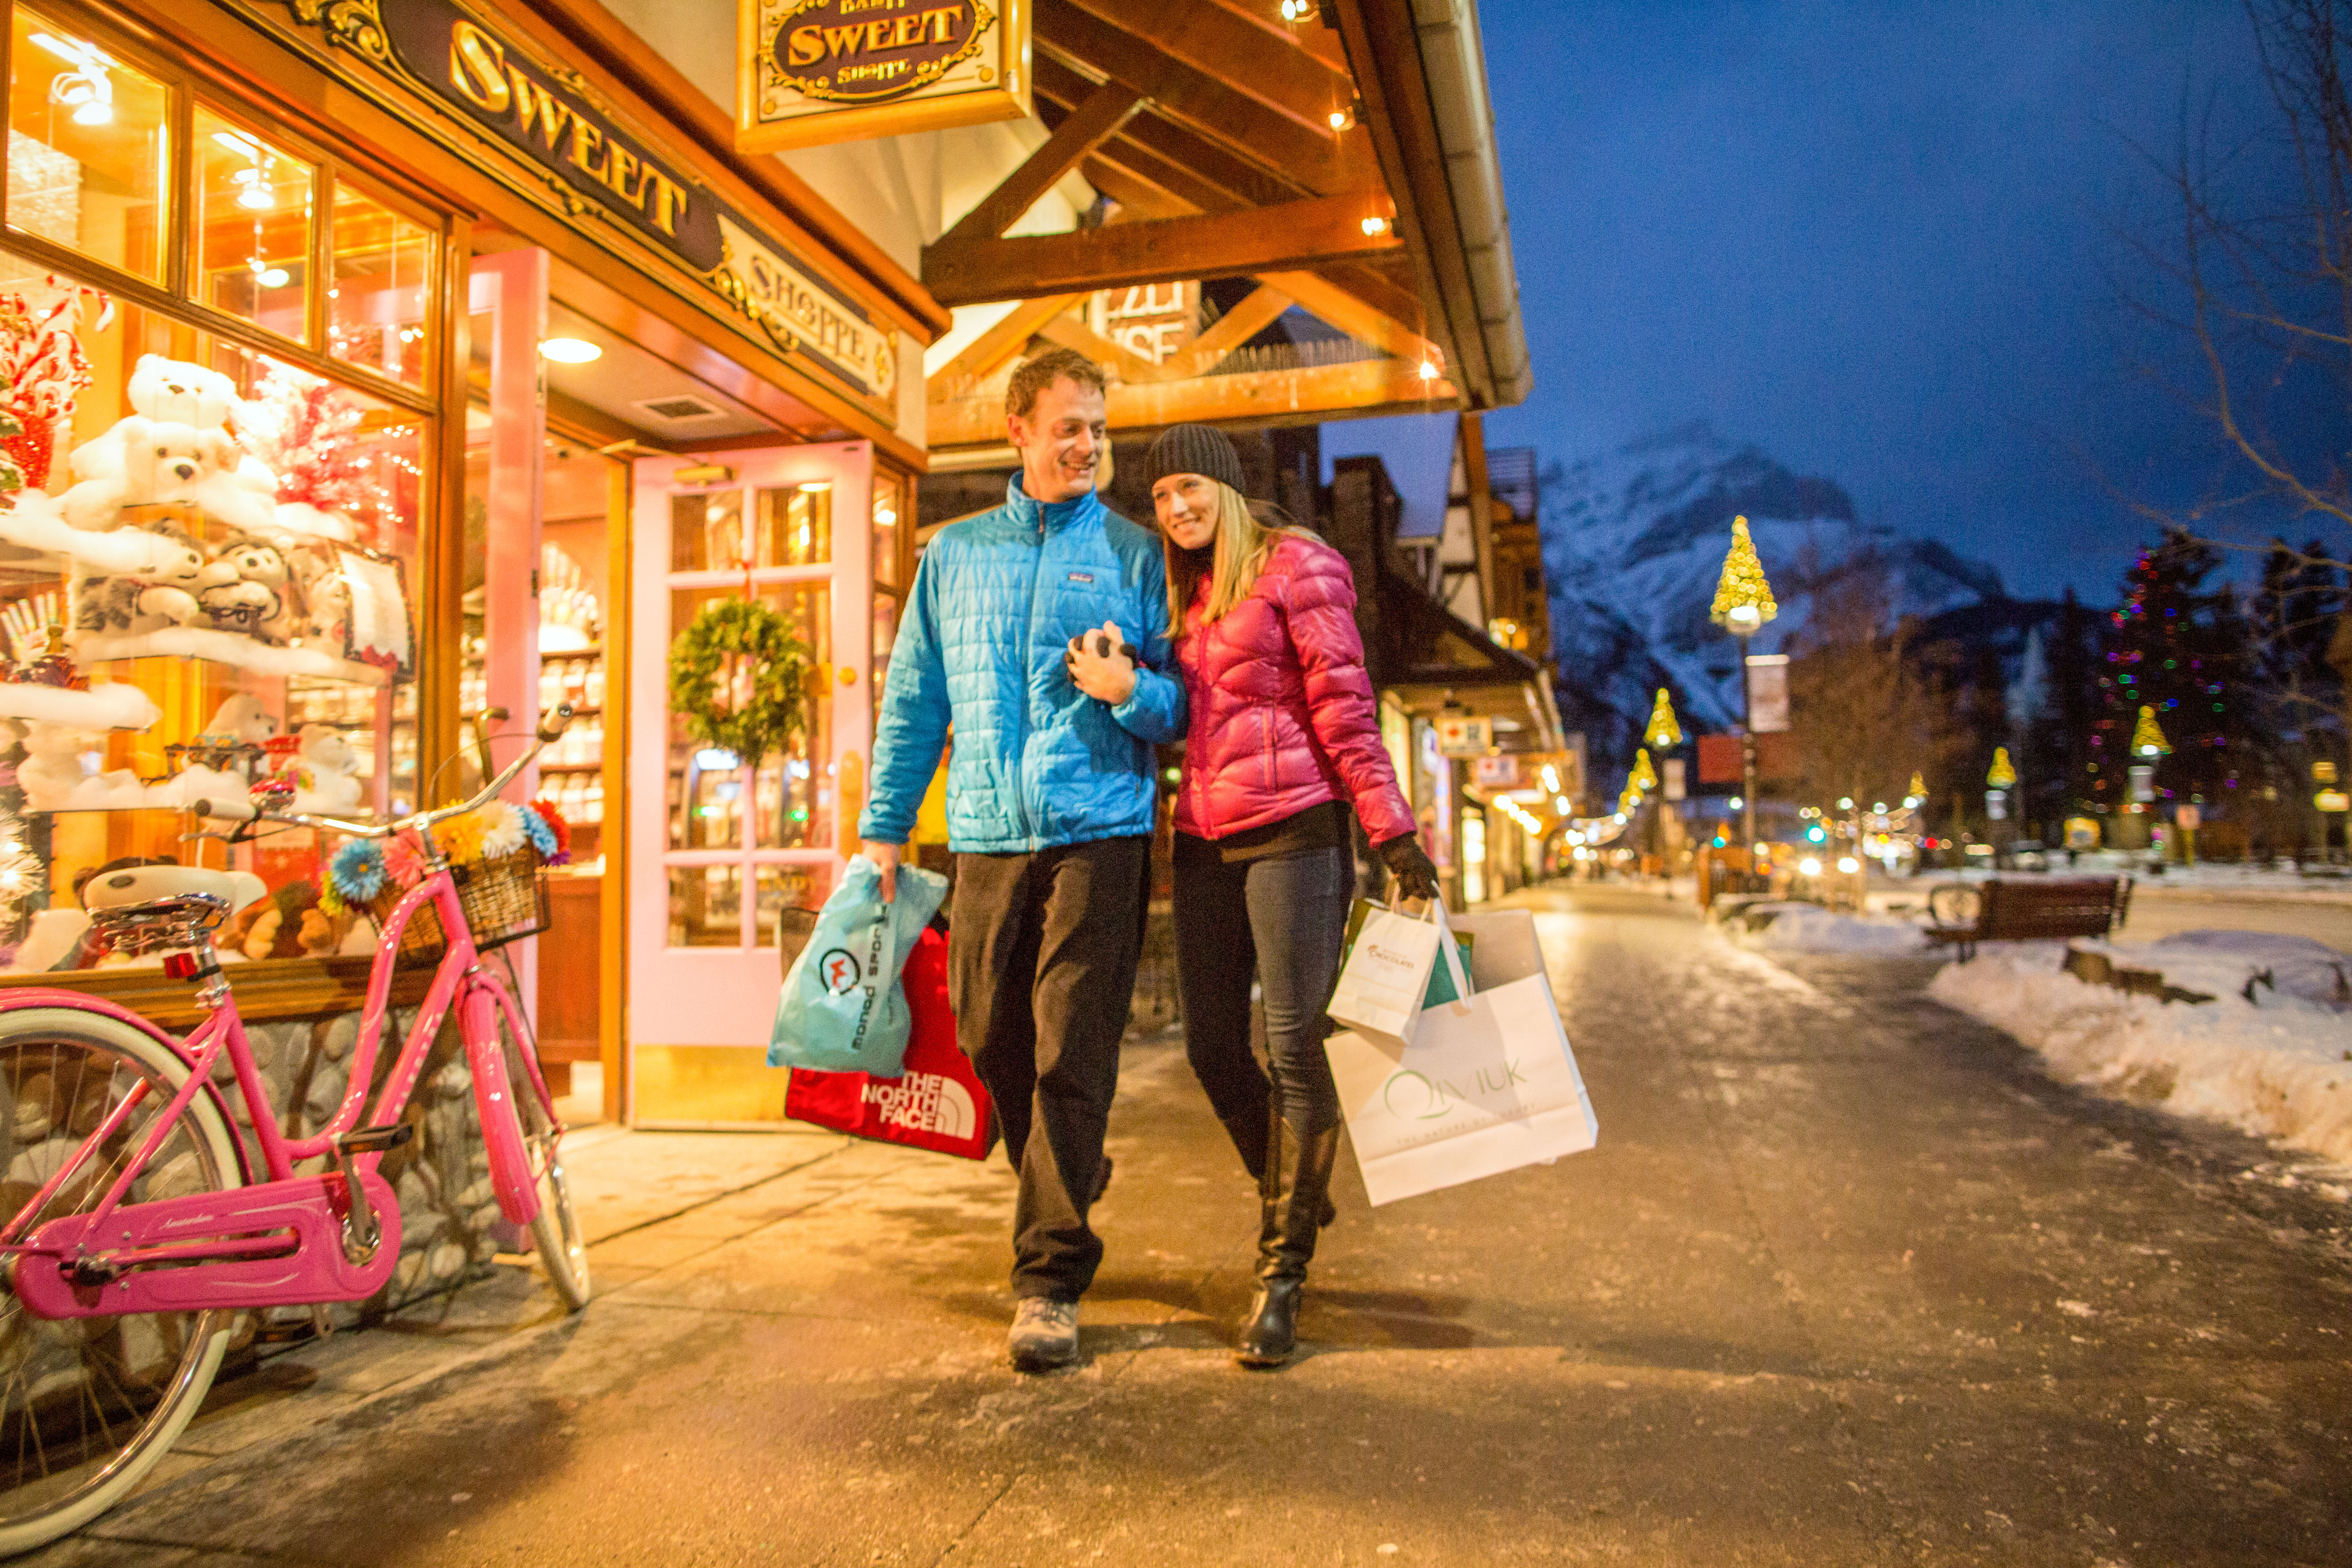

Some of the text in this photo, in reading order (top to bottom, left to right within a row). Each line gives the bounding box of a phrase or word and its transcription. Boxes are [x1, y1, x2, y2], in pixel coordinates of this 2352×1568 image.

[788, 5, 962, 66] SWEET
[450, 19, 686, 237] SWEET
[751, 255, 867, 363] SHOPPE
[860, 1082, 939, 1114] NORTH
[902, 1070, 942, 1095] THE
[879, 1103, 936, 1132] FACE
